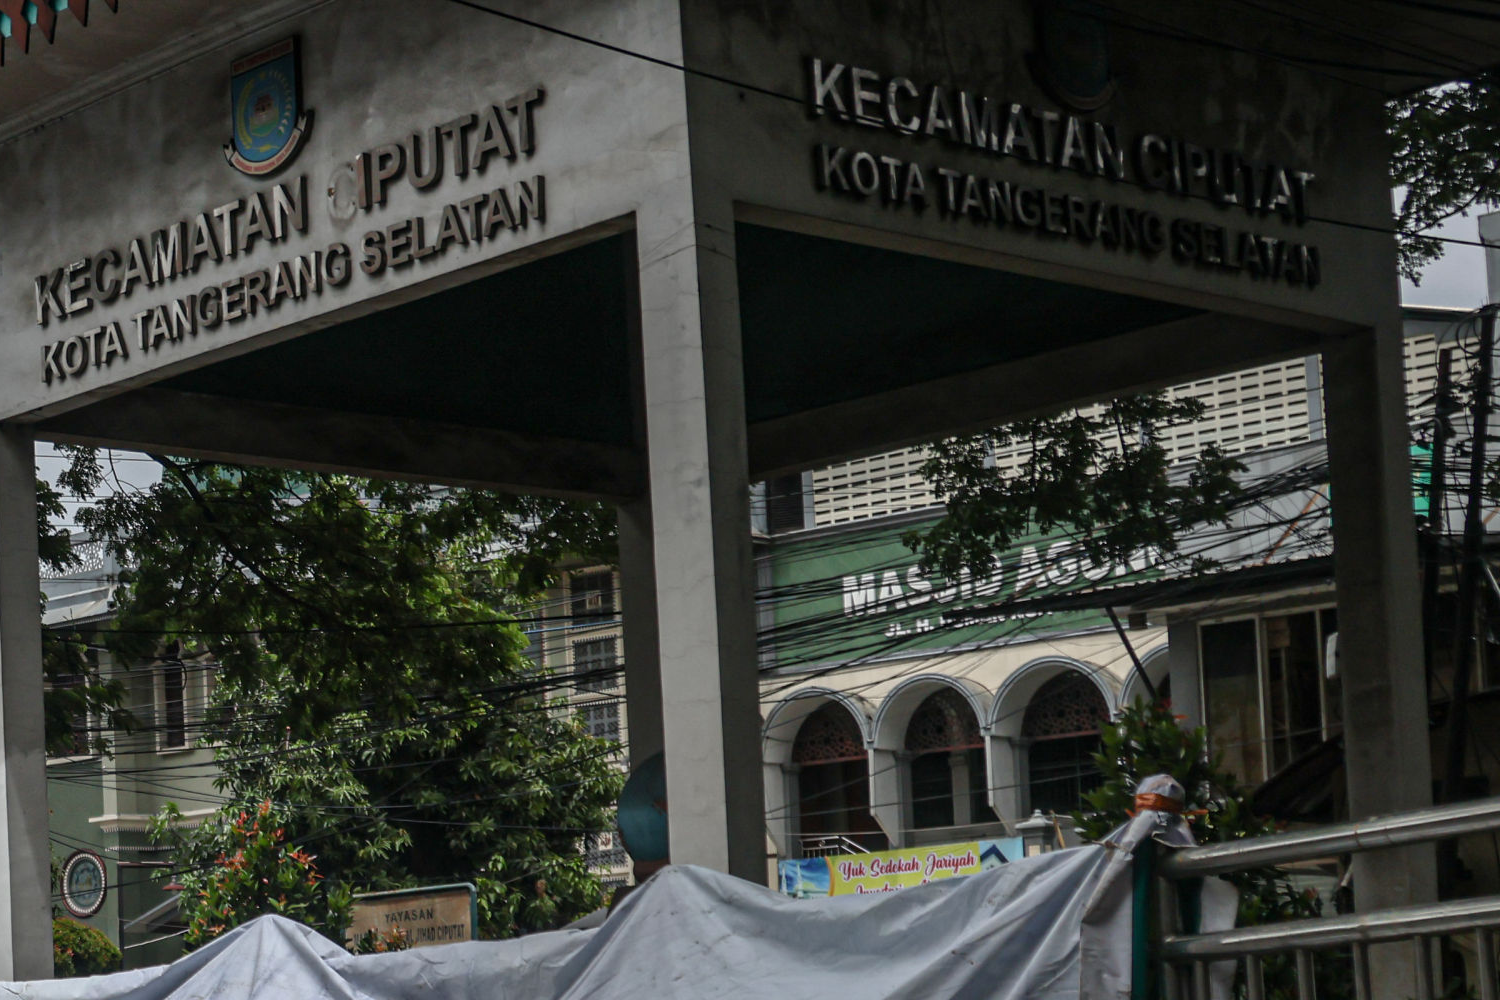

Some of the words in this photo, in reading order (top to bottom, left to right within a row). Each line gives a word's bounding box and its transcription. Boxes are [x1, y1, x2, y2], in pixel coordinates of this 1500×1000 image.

[809, 58, 1125, 180] KECAMATAN
[1137, 133, 1316, 224] CIPUTAT
[33, 176, 308, 326] KECAMATAN
[41, 322, 128, 383] KOTA
[133, 243, 352, 352] TANGERANG
[360, 175, 545, 276] SELATAN
[816, 143, 927, 203] KOTA
[934, 166, 1165, 253] TANGERANG
[1171, 217, 1321, 287] SELATAN
[385, 908, 434, 923] YAYASAN
[437, 924, 465, 940] CIPUTAT
[838, 861, 866, 883] Yuk
[869, 855, 921, 878] Sedekah
[924, 850, 976, 880] Jariyah
